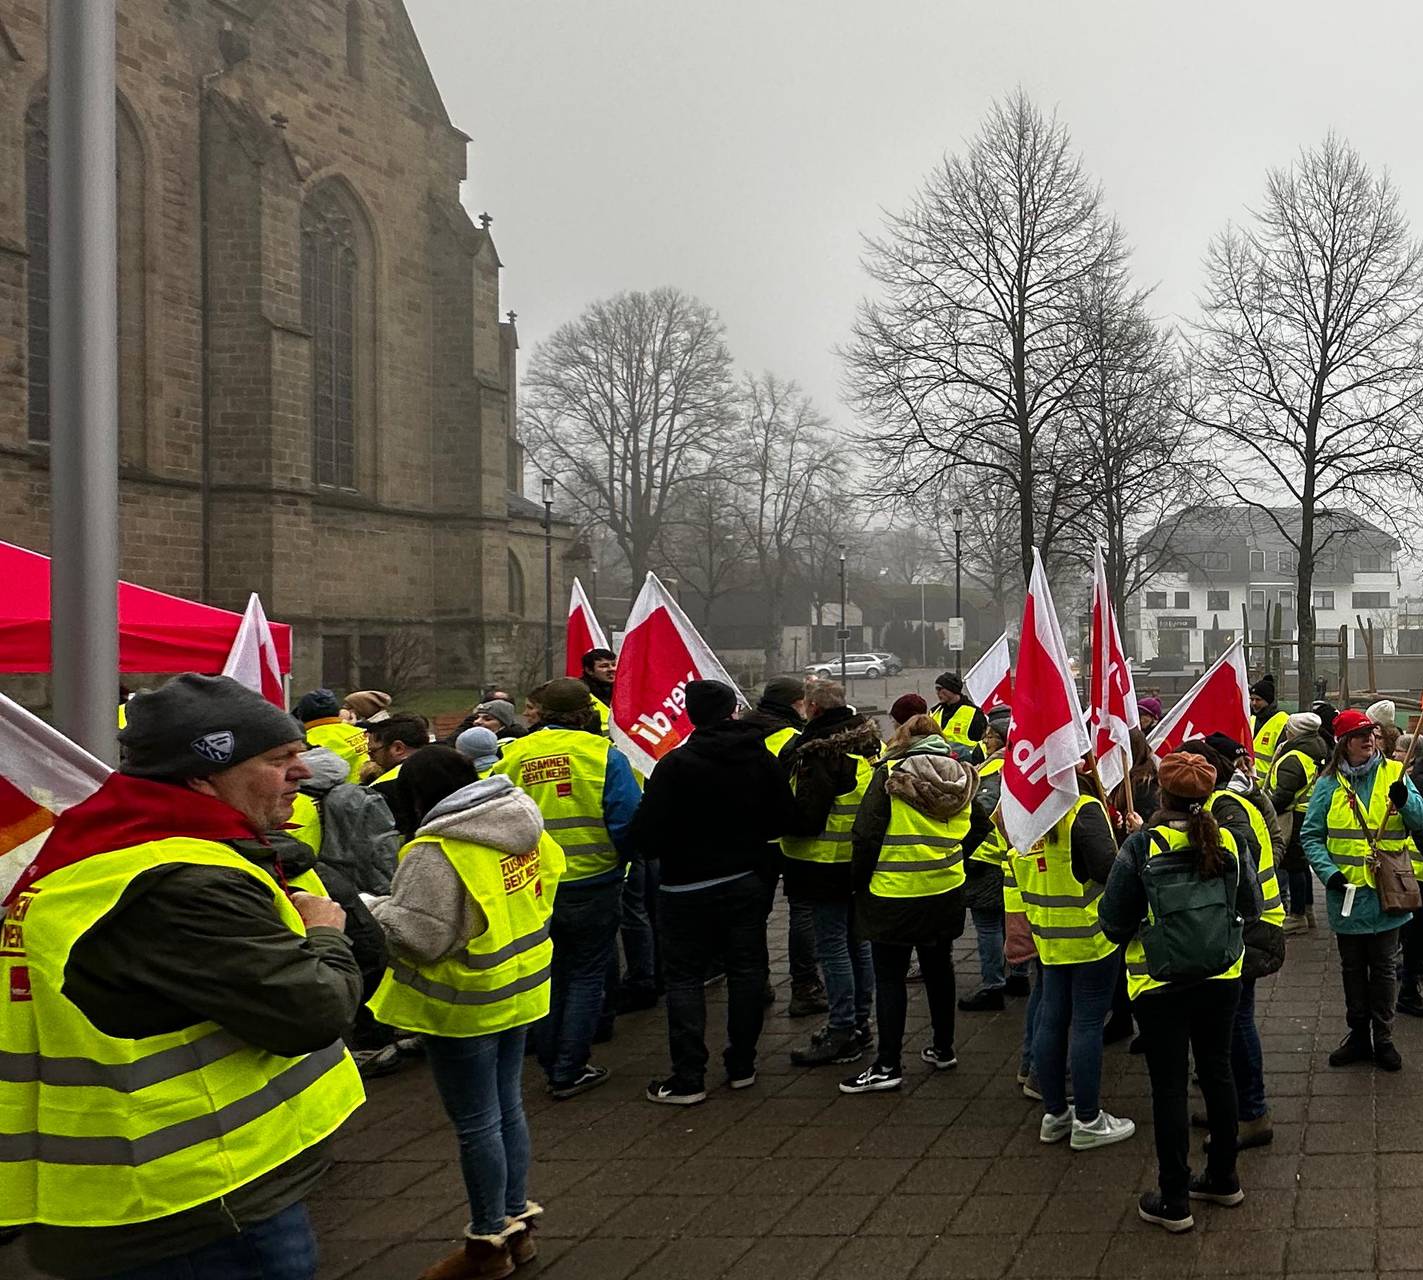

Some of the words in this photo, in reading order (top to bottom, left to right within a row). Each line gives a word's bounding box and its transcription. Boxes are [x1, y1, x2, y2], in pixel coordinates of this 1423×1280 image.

[520, 756, 570, 773] ZUSAMMEN
[522, 771, 544, 783] GEHT
[546, 767, 571, 779] MEHR
